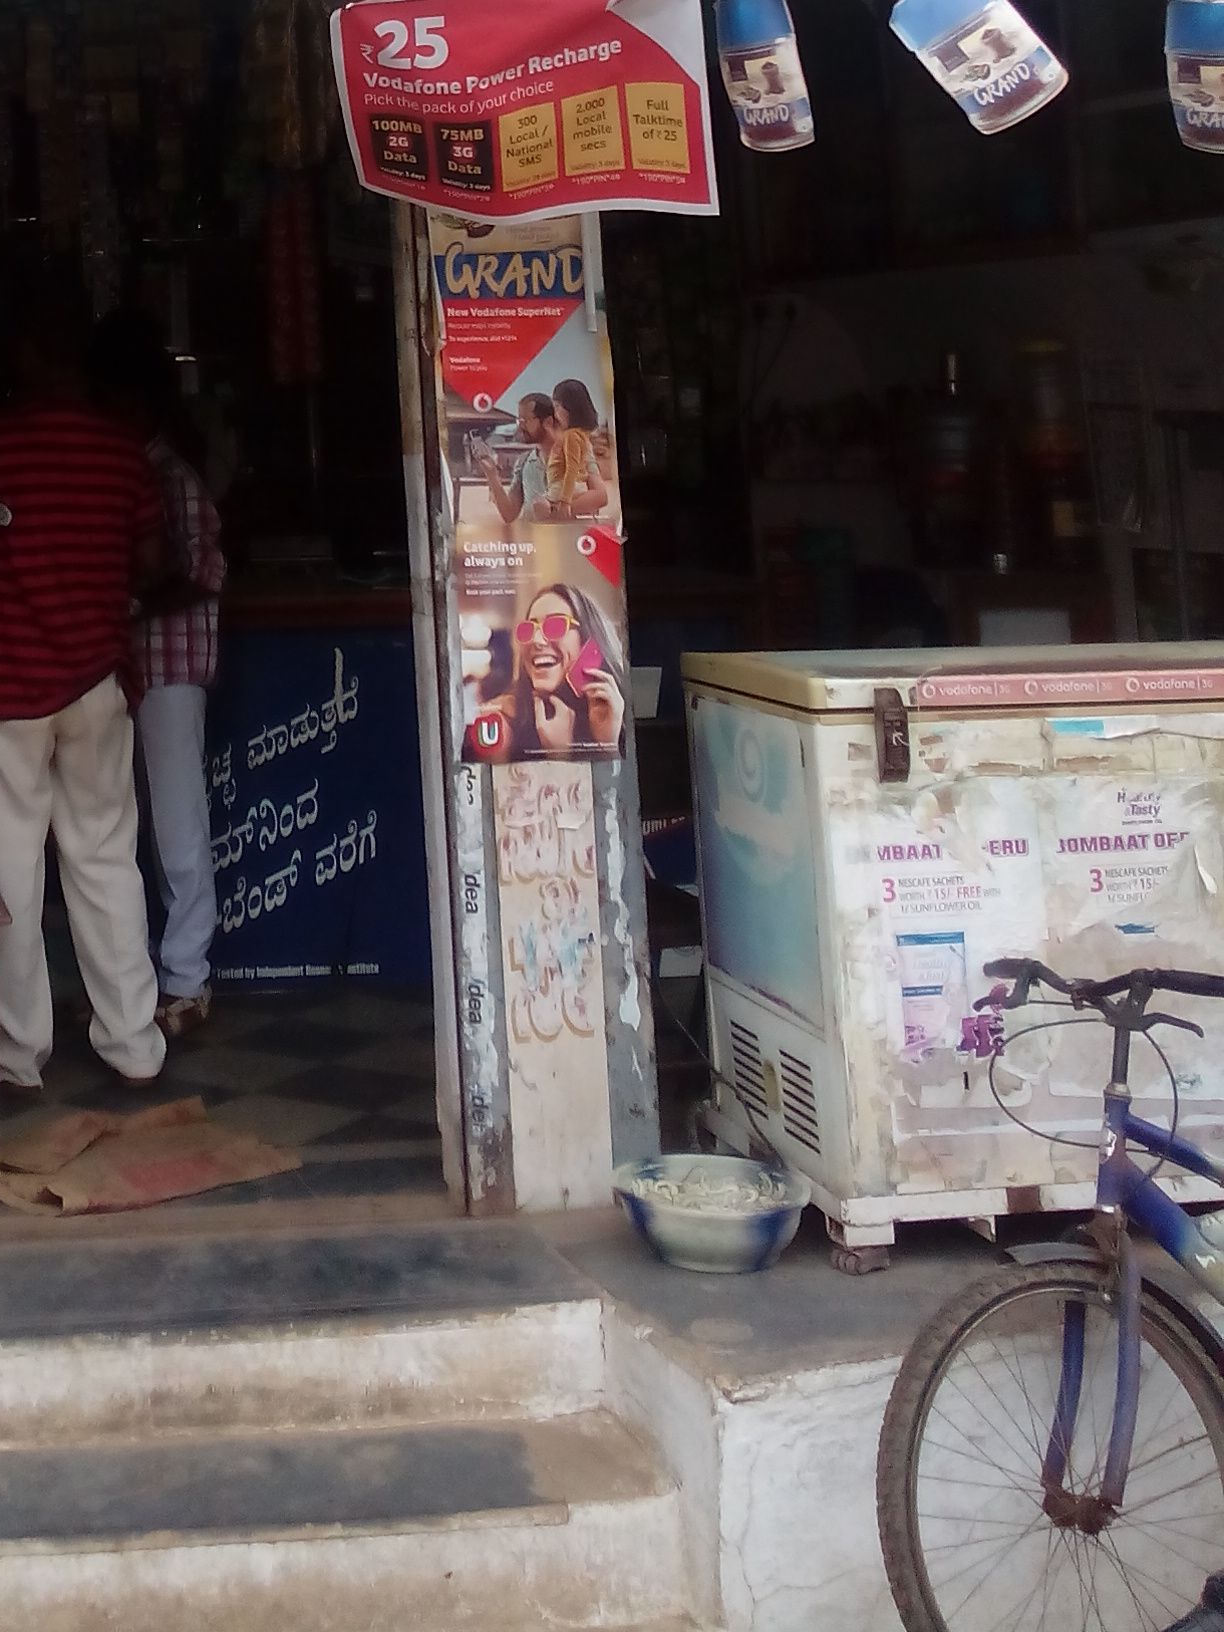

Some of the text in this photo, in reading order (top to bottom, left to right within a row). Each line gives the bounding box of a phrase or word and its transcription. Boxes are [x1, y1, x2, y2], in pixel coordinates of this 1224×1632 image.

[363, 38, 623, 96] Vodafone Power Recharge
[973, 62, 1032, 107] GRAND
[364, 79, 555, 116] Pick the pack of your choice
[646, 99, 670, 112] Full
[517, 114, 538, 129] 300
[577, 111, 607, 126] Local
[633, 114, 684, 128] Talktime
[742, 103, 791, 125] GRAND
[1185, 107, 1224, 128] GRA
[372, 119, 423, 135] 100MB
[573, 124, 613, 141] mobile
[389, 136, 409, 149] 2G
[440, 128, 485, 142] 75MB
[509, 129, 540, 145] Local
[642, 130, 655, 142] of
[451, 145, 474, 159] 3G
[506, 139, 553, 159] National
[580, 140, 607, 152] secs
[384, 150, 418, 165] Data
[518, 153, 543, 168] SMS
[447, 159, 483, 175] Data
[445, 241, 585, 299] GRAND
[470, 306, 517, 318] Vodafone
[464, 541, 517, 555] Catching
[464, 556, 523, 568] always on
[939, 683, 993, 697] vodafone
[1041, 681, 1095, 694] vodafone
[1142, 677, 1196, 691] vodafone
[1089, 869, 1104, 893] 3
[881, 878, 897, 904] 3
[957, 886, 982, 899] FREE
